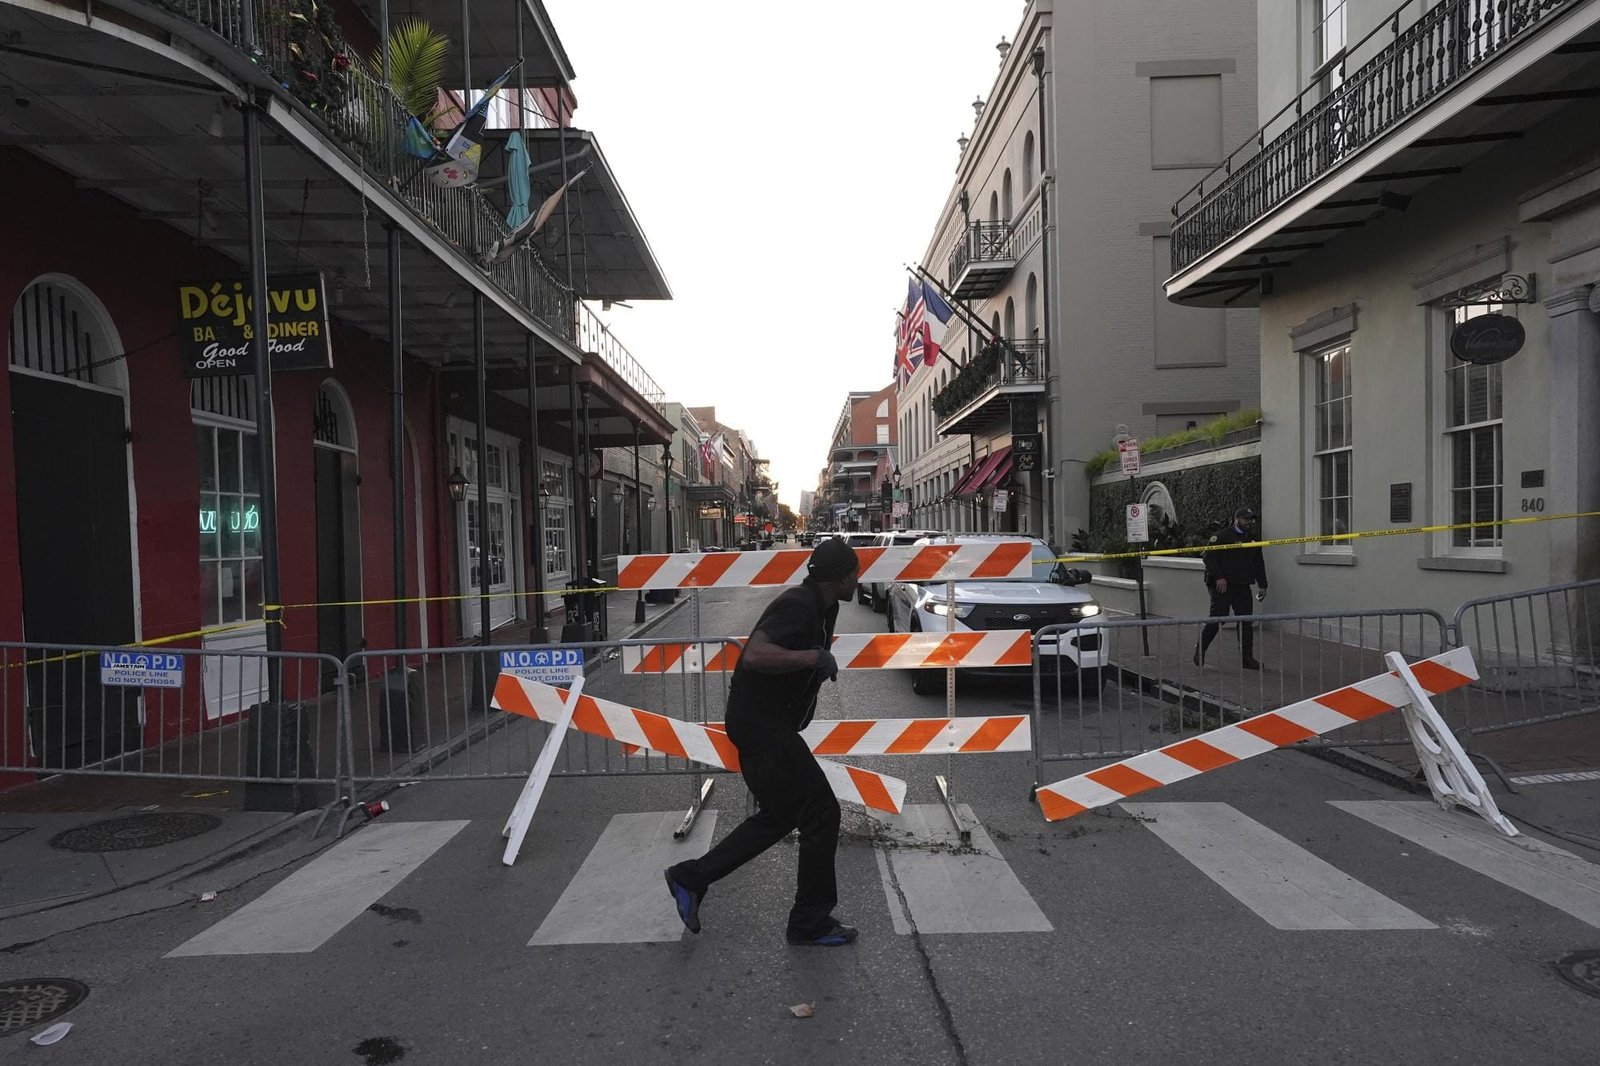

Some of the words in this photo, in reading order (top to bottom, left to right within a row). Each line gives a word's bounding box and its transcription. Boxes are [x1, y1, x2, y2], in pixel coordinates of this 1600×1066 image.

[193, 326, 220, 342] BA
[243, 323, 254, 339] &
[268, 320, 319, 338] DINER
[203, 341, 249, 362] Good
[268, 337, 306, 353] Food
[195, 359, 236, 370] OPEN
[1521, 497, 1545, 513] 840
[104, 653, 131, 667] NO
